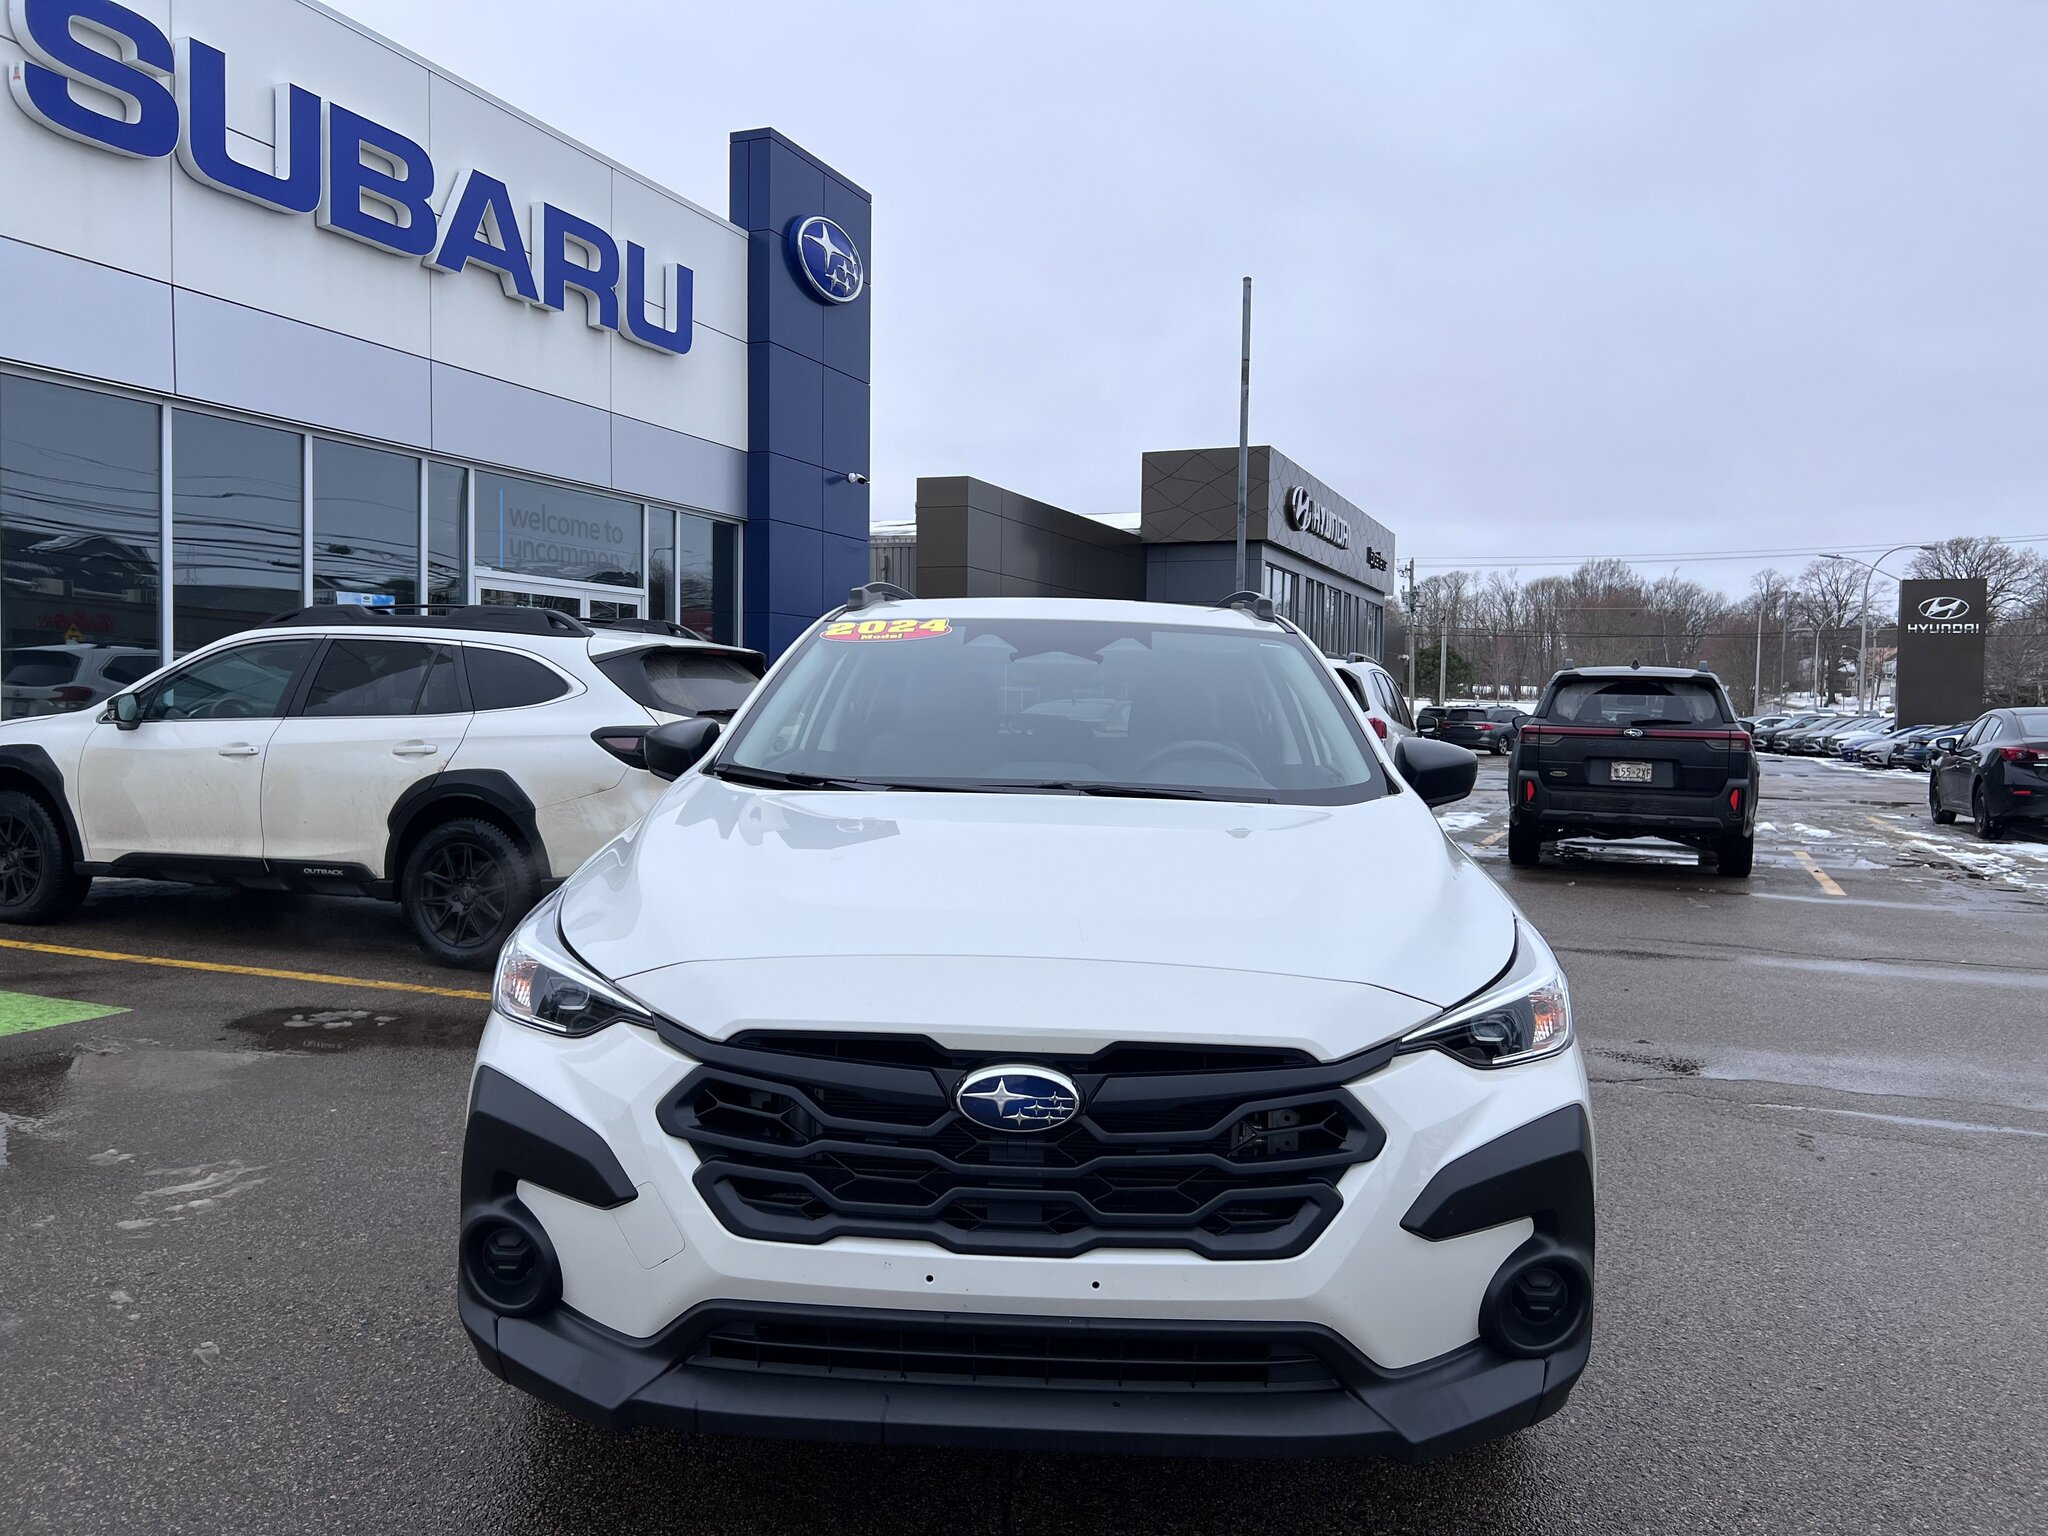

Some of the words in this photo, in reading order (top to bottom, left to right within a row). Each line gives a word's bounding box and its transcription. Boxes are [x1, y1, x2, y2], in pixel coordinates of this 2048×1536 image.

[12, 0, 694, 355] SUBARU
[509, 503, 599, 541] welcome
[604, 519, 624, 545] to
[1312, 500, 1351, 548] HYUNDAI
[509, 537, 620, 568] uncommon
[825, 618, 949, 636] 2024
[1907, 623, 1980, 634] HYUNDAI
[303, 867, 344, 876] OUTBACK
